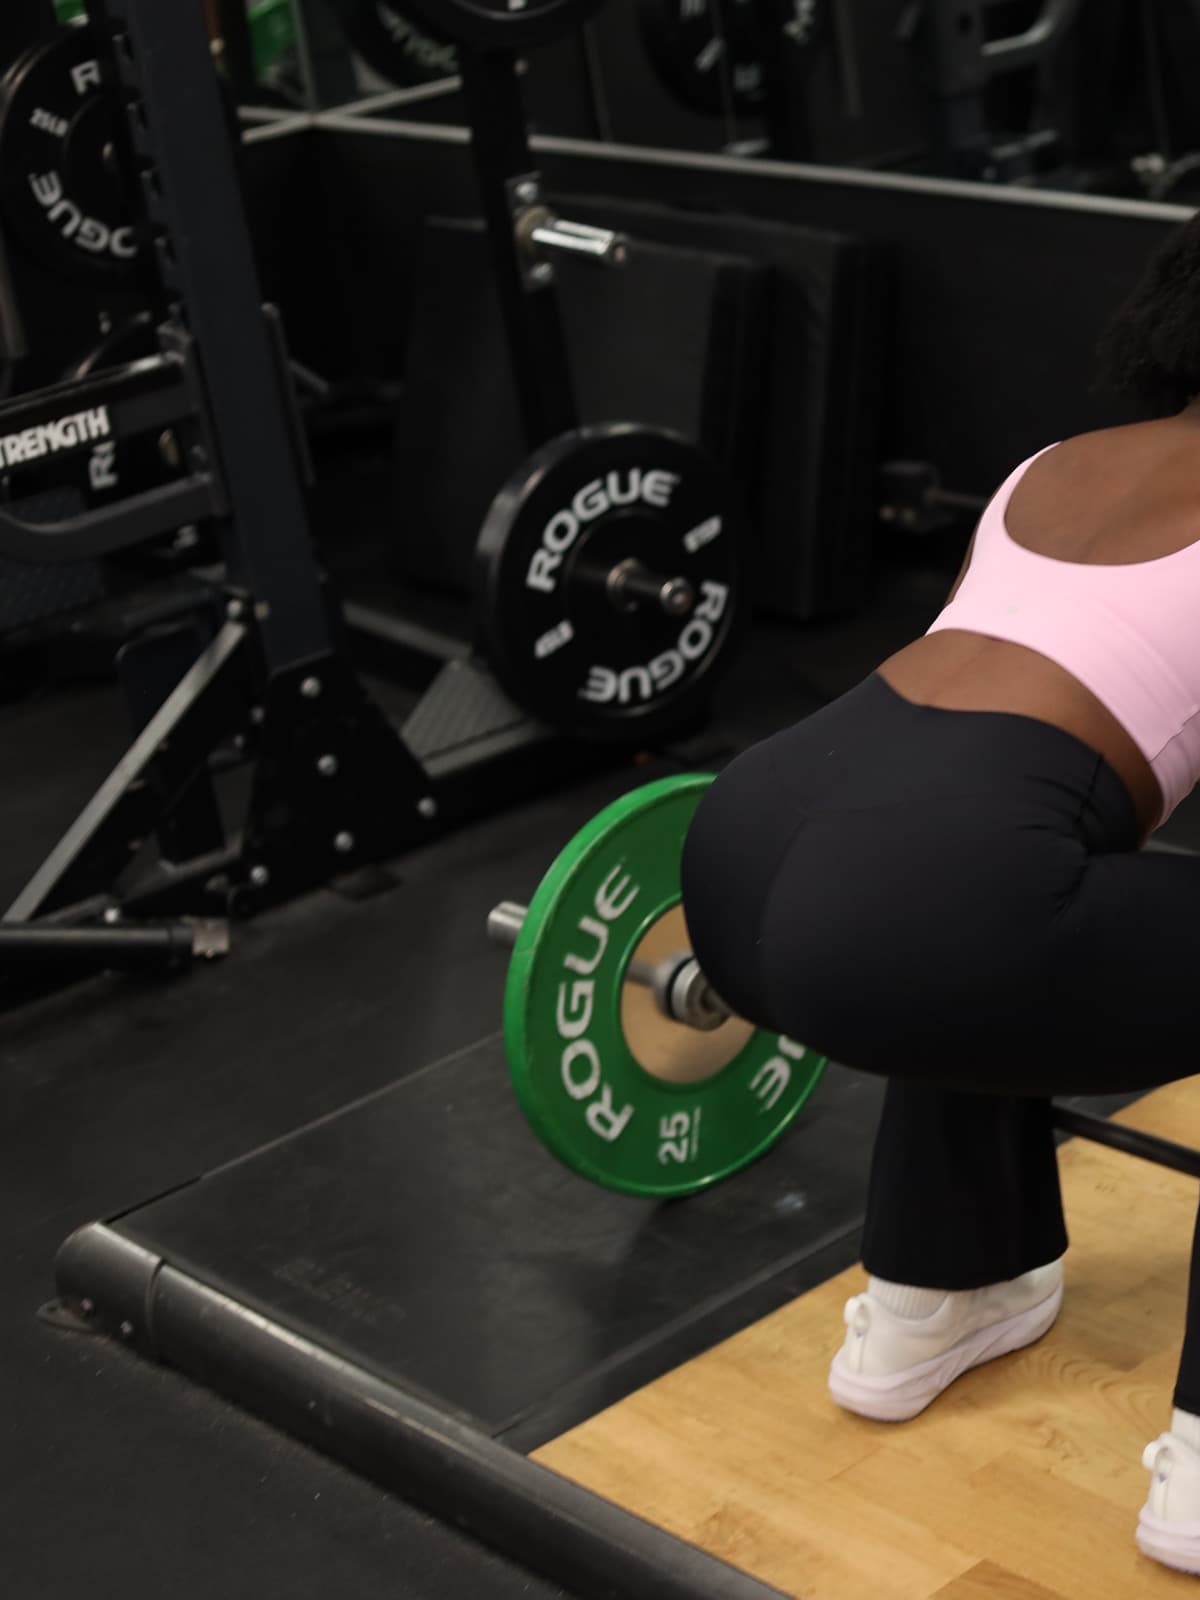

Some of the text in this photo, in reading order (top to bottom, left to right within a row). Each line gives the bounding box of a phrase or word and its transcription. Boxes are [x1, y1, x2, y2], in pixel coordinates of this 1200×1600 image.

[28, 169, 138, 259] OGUE
[0, 404, 111, 470] TRENGTH
[527, 468, 680, 593] ROGUE
[578, 580, 728, 703] ROGUE
[556, 860, 641, 1142] ROGUE
[658, 1110, 690, 1165] 25
